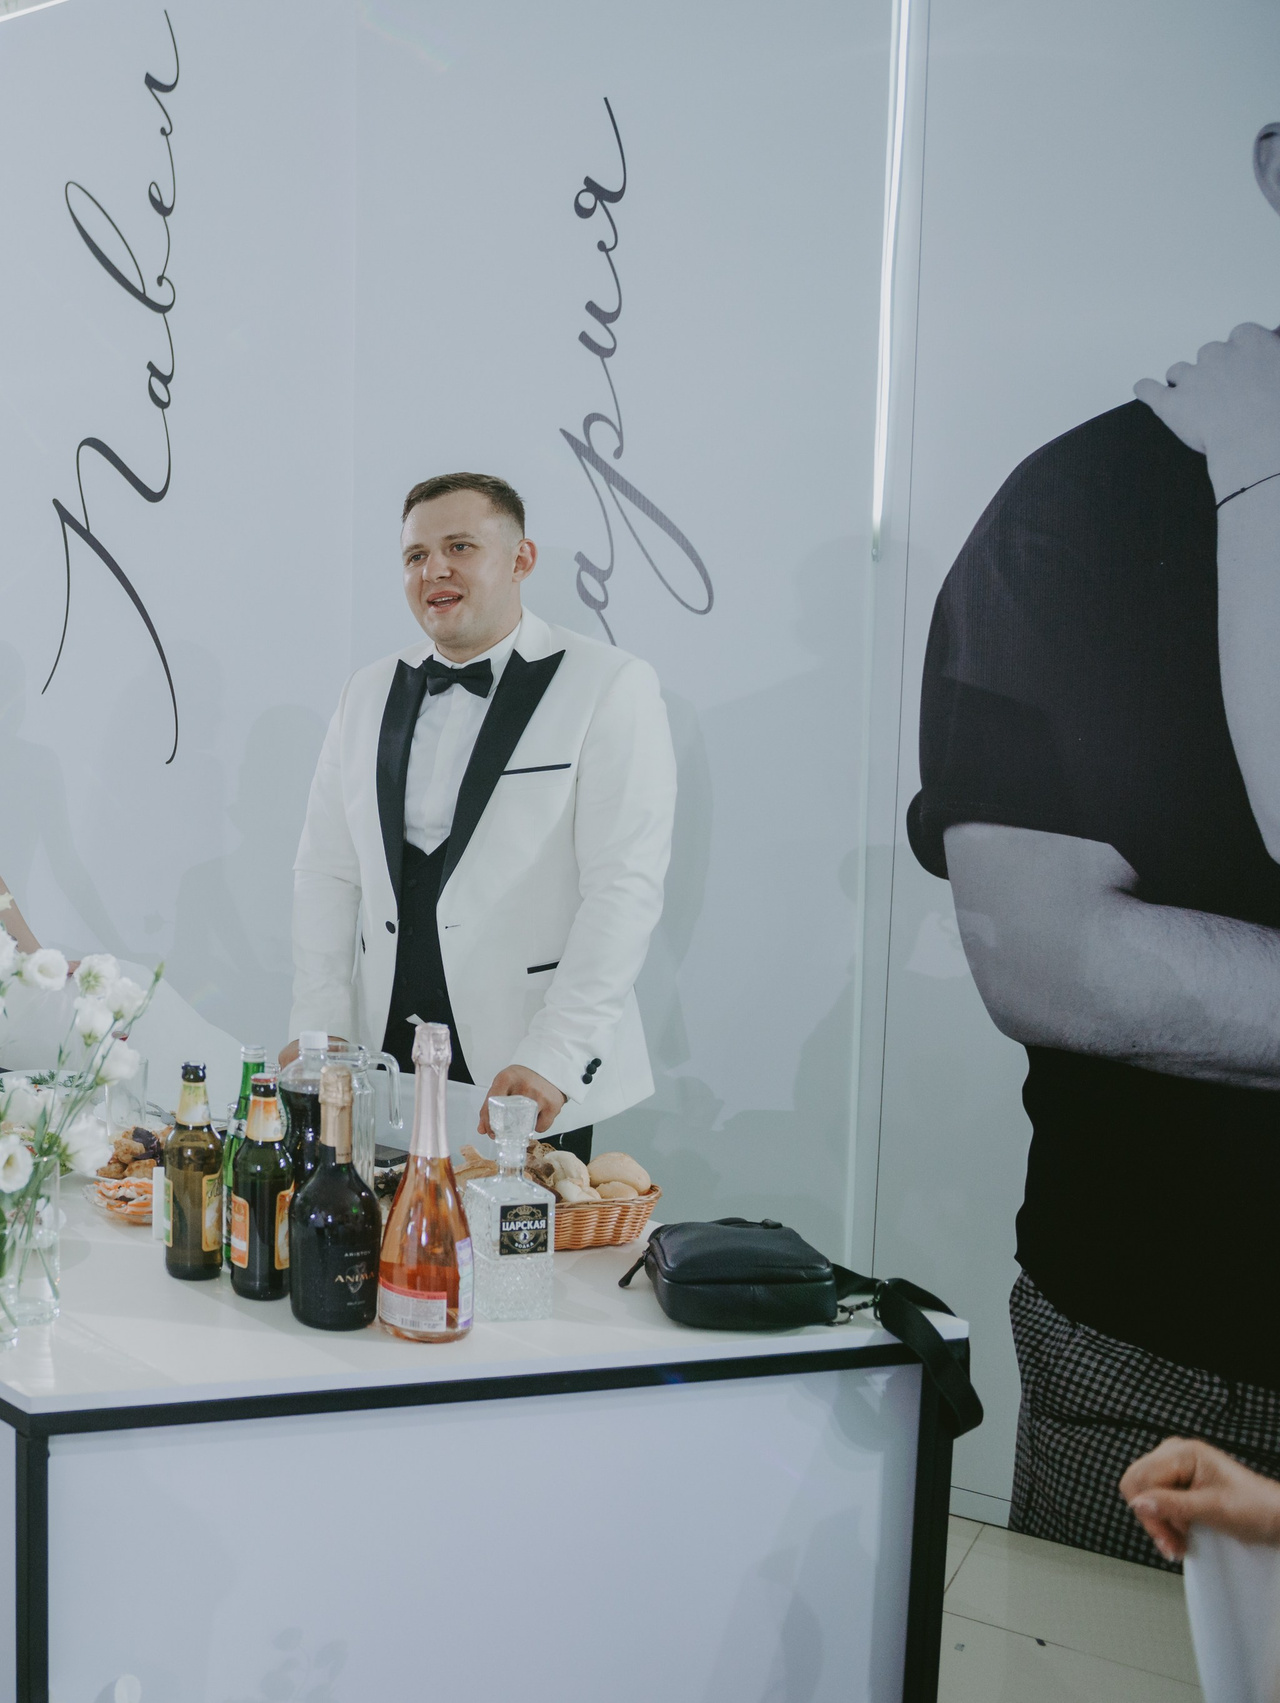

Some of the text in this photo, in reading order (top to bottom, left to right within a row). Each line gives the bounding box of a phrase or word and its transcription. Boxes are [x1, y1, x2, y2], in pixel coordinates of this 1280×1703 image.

[558, 96, 715, 647] ария
[501, 1219, 547, 1232] ЦАРСКАЯ
[514, 1241, 535, 1249] ВОДКА
